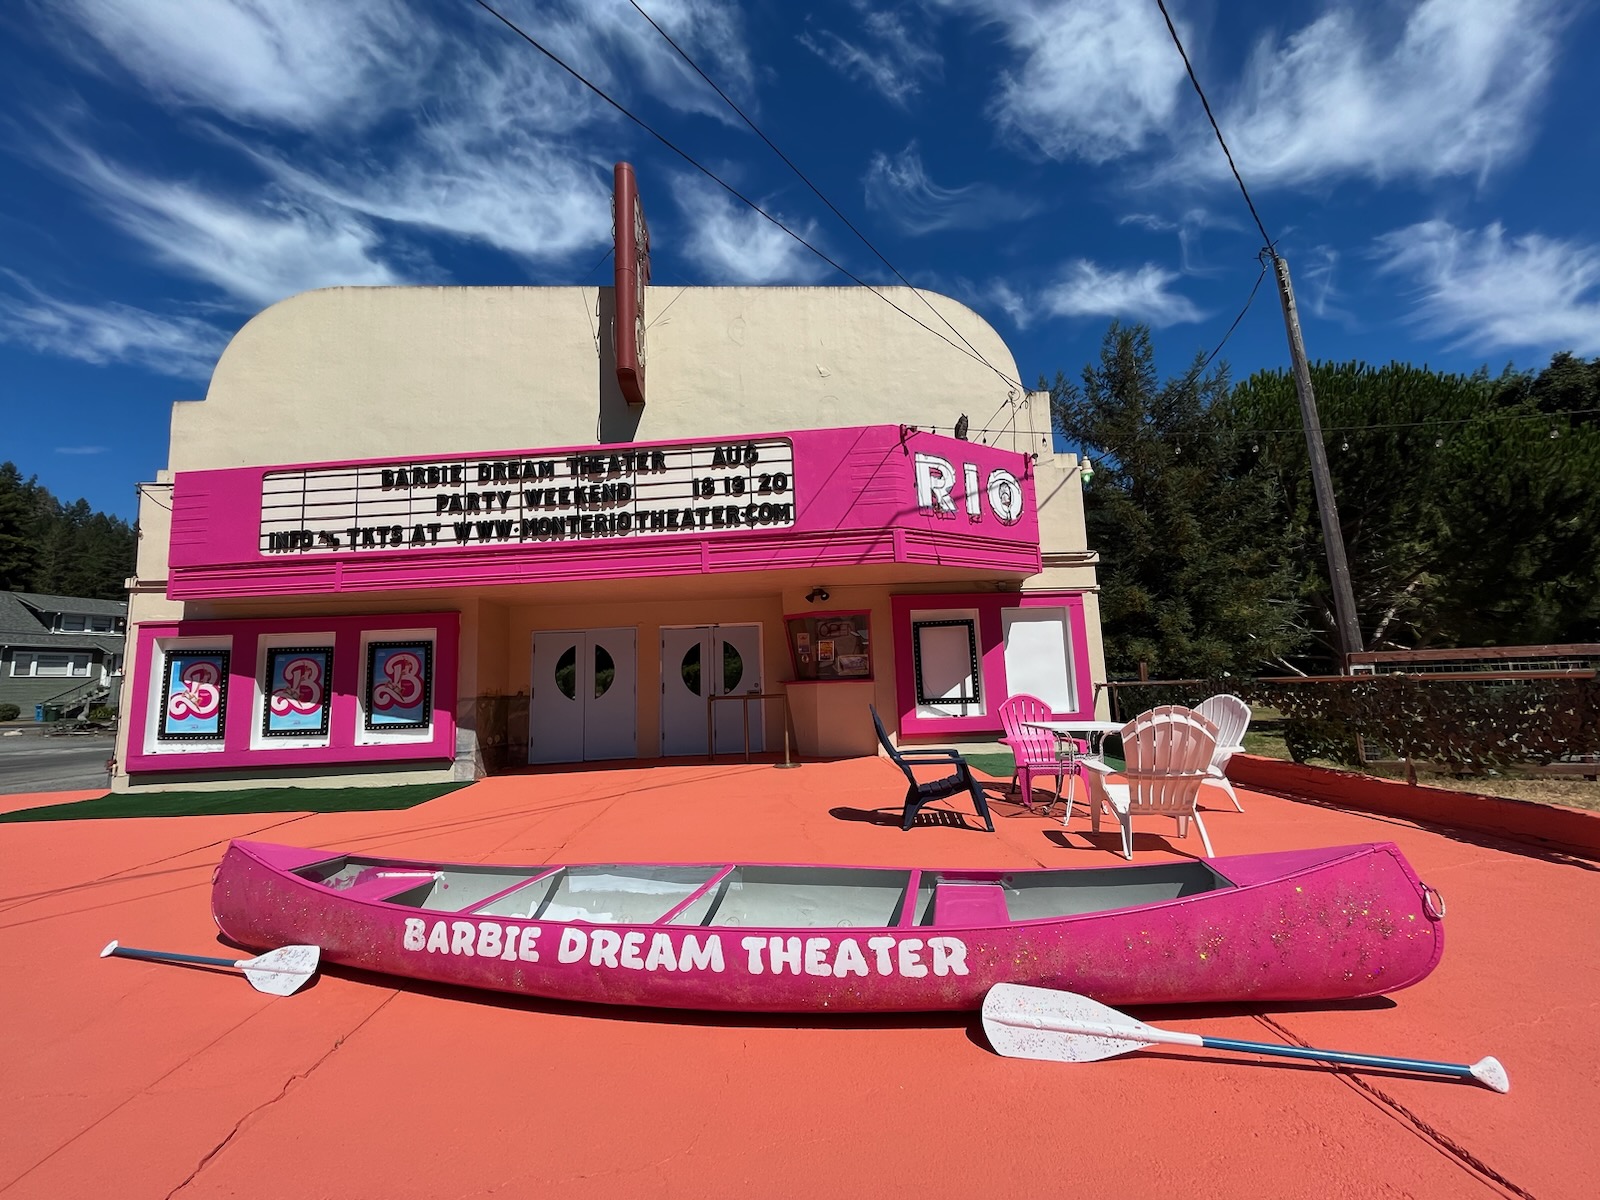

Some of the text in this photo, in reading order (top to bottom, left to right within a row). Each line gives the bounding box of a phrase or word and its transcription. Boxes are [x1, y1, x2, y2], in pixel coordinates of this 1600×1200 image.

[382, 452, 666, 489] BARBIE DREAM THEATER
[711, 444, 759, 467] AUG
[436, 483, 632, 514] PARTY WEEKEND
[693, 472, 788, 497] 18 19 20
[915, 452, 1023, 524] RIO
[268, 530, 313, 553] INFO
[347, 525, 403, 547] TKTS
[412, 522, 441, 543] AT
[403, 917, 970, 978] BARBIE DREAM THEATER
